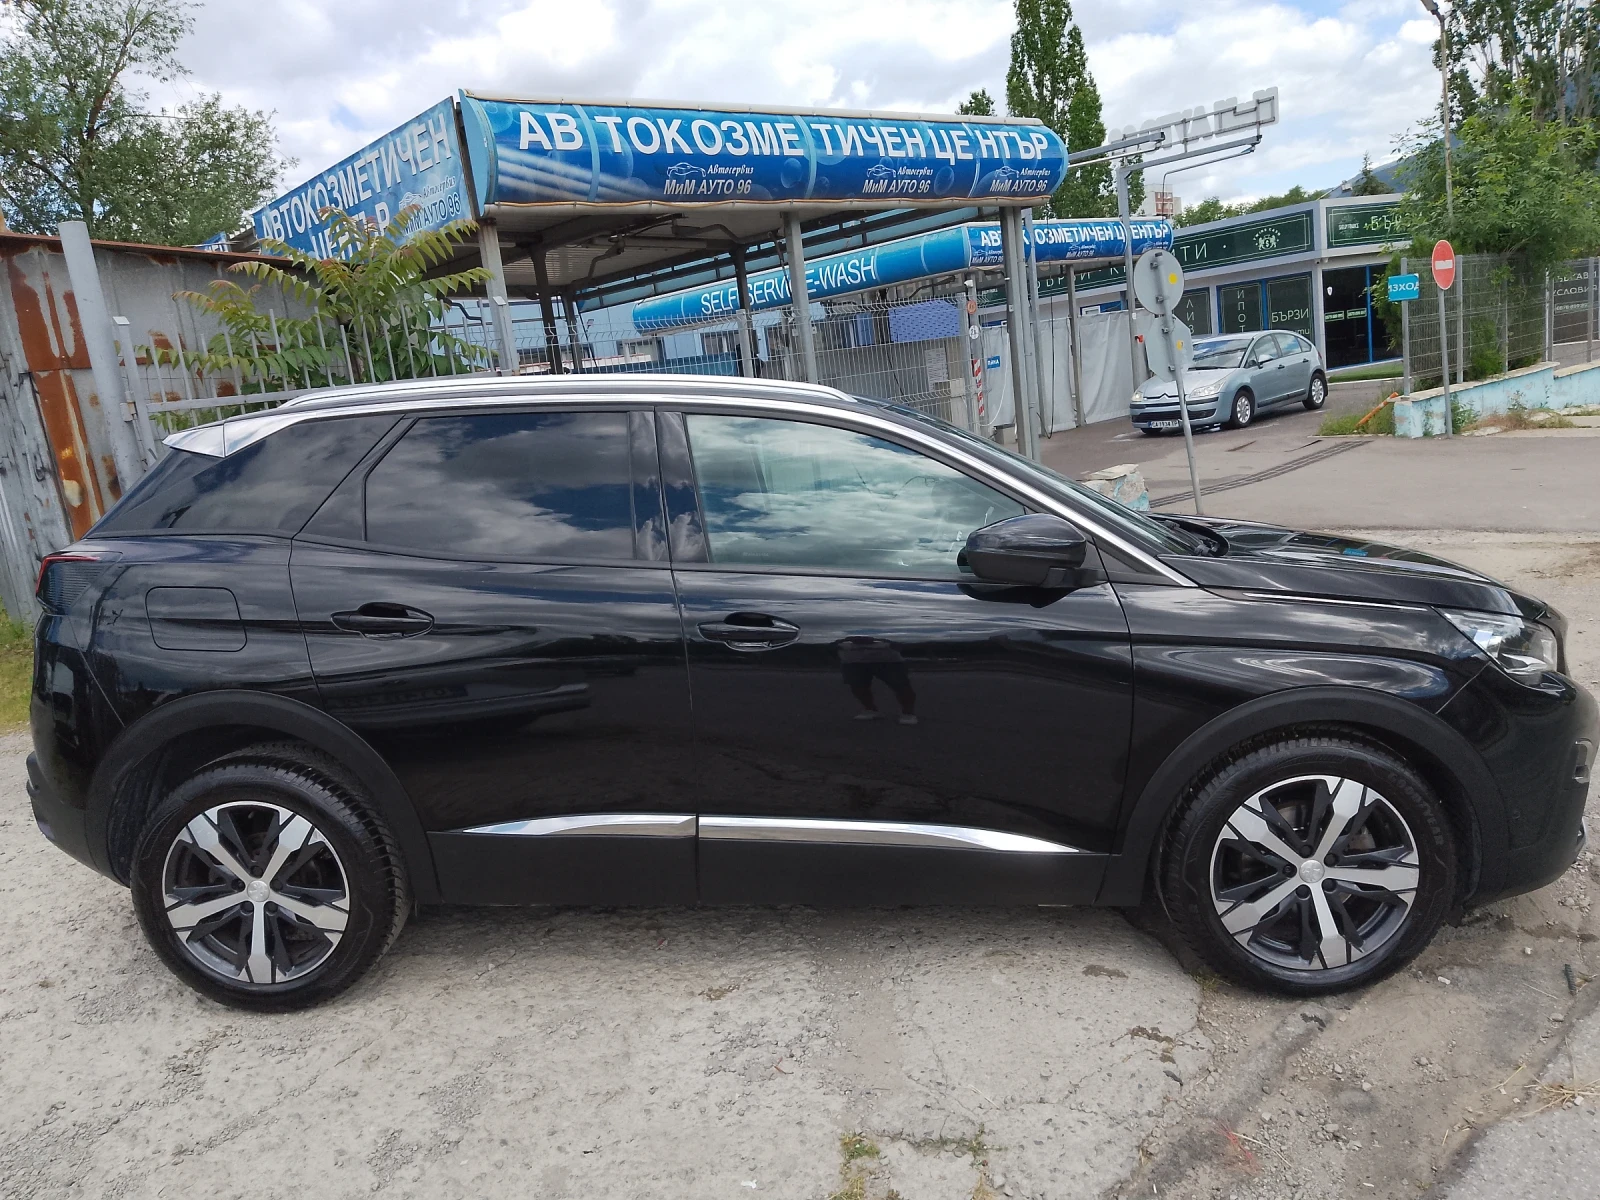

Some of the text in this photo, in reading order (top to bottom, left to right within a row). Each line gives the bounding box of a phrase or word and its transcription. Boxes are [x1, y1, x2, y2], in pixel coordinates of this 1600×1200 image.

[261, 113, 453, 243] АВТОКОЗМЕТИЧЕН
[707, 164, 754, 177] Автосервиз
[663, 179, 752, 195] МиМ АУТО 96
[887, 179, 918, 194] АУТО
[917, 179, 931, 193] 96
[1035, 179, 1048, 191] 96
[422, 198, 447, 226] АУТО
[446, 192, 461, 217] 96
[747, 255, 877, 307] SERVIE-WASH
[1271, 307, 1309, 323] БЪРЗИ
